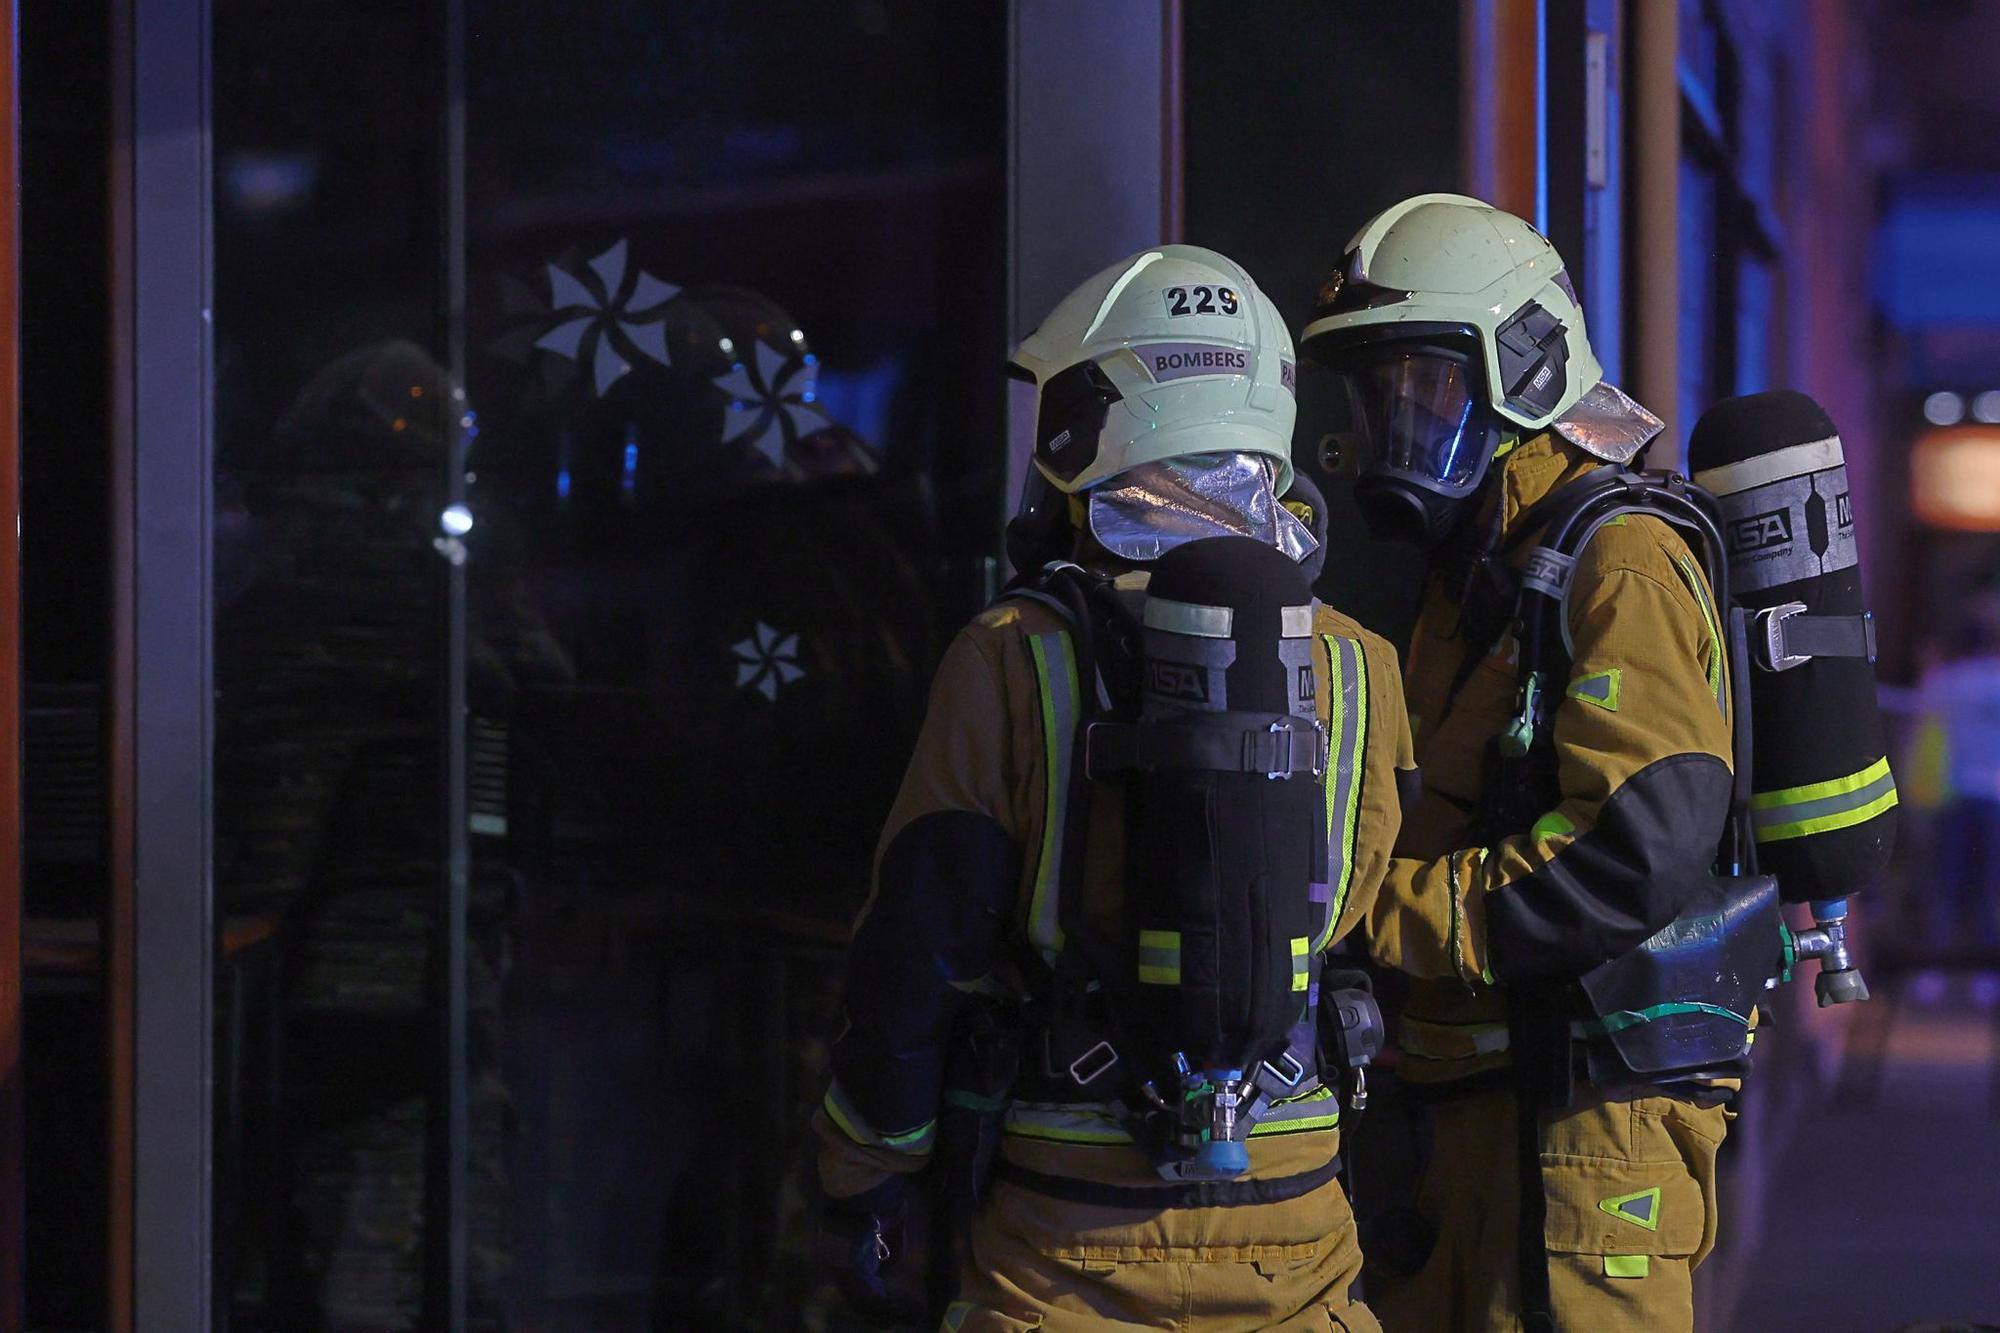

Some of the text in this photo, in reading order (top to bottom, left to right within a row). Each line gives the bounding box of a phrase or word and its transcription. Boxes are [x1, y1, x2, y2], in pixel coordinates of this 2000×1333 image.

[1167, 286, 1238, 316] 229
[1156, 352, 1246, 371] BOMBERS
[1534, 367, 1550, 388] MSA
[1753, 547, 1793, 561] Company
